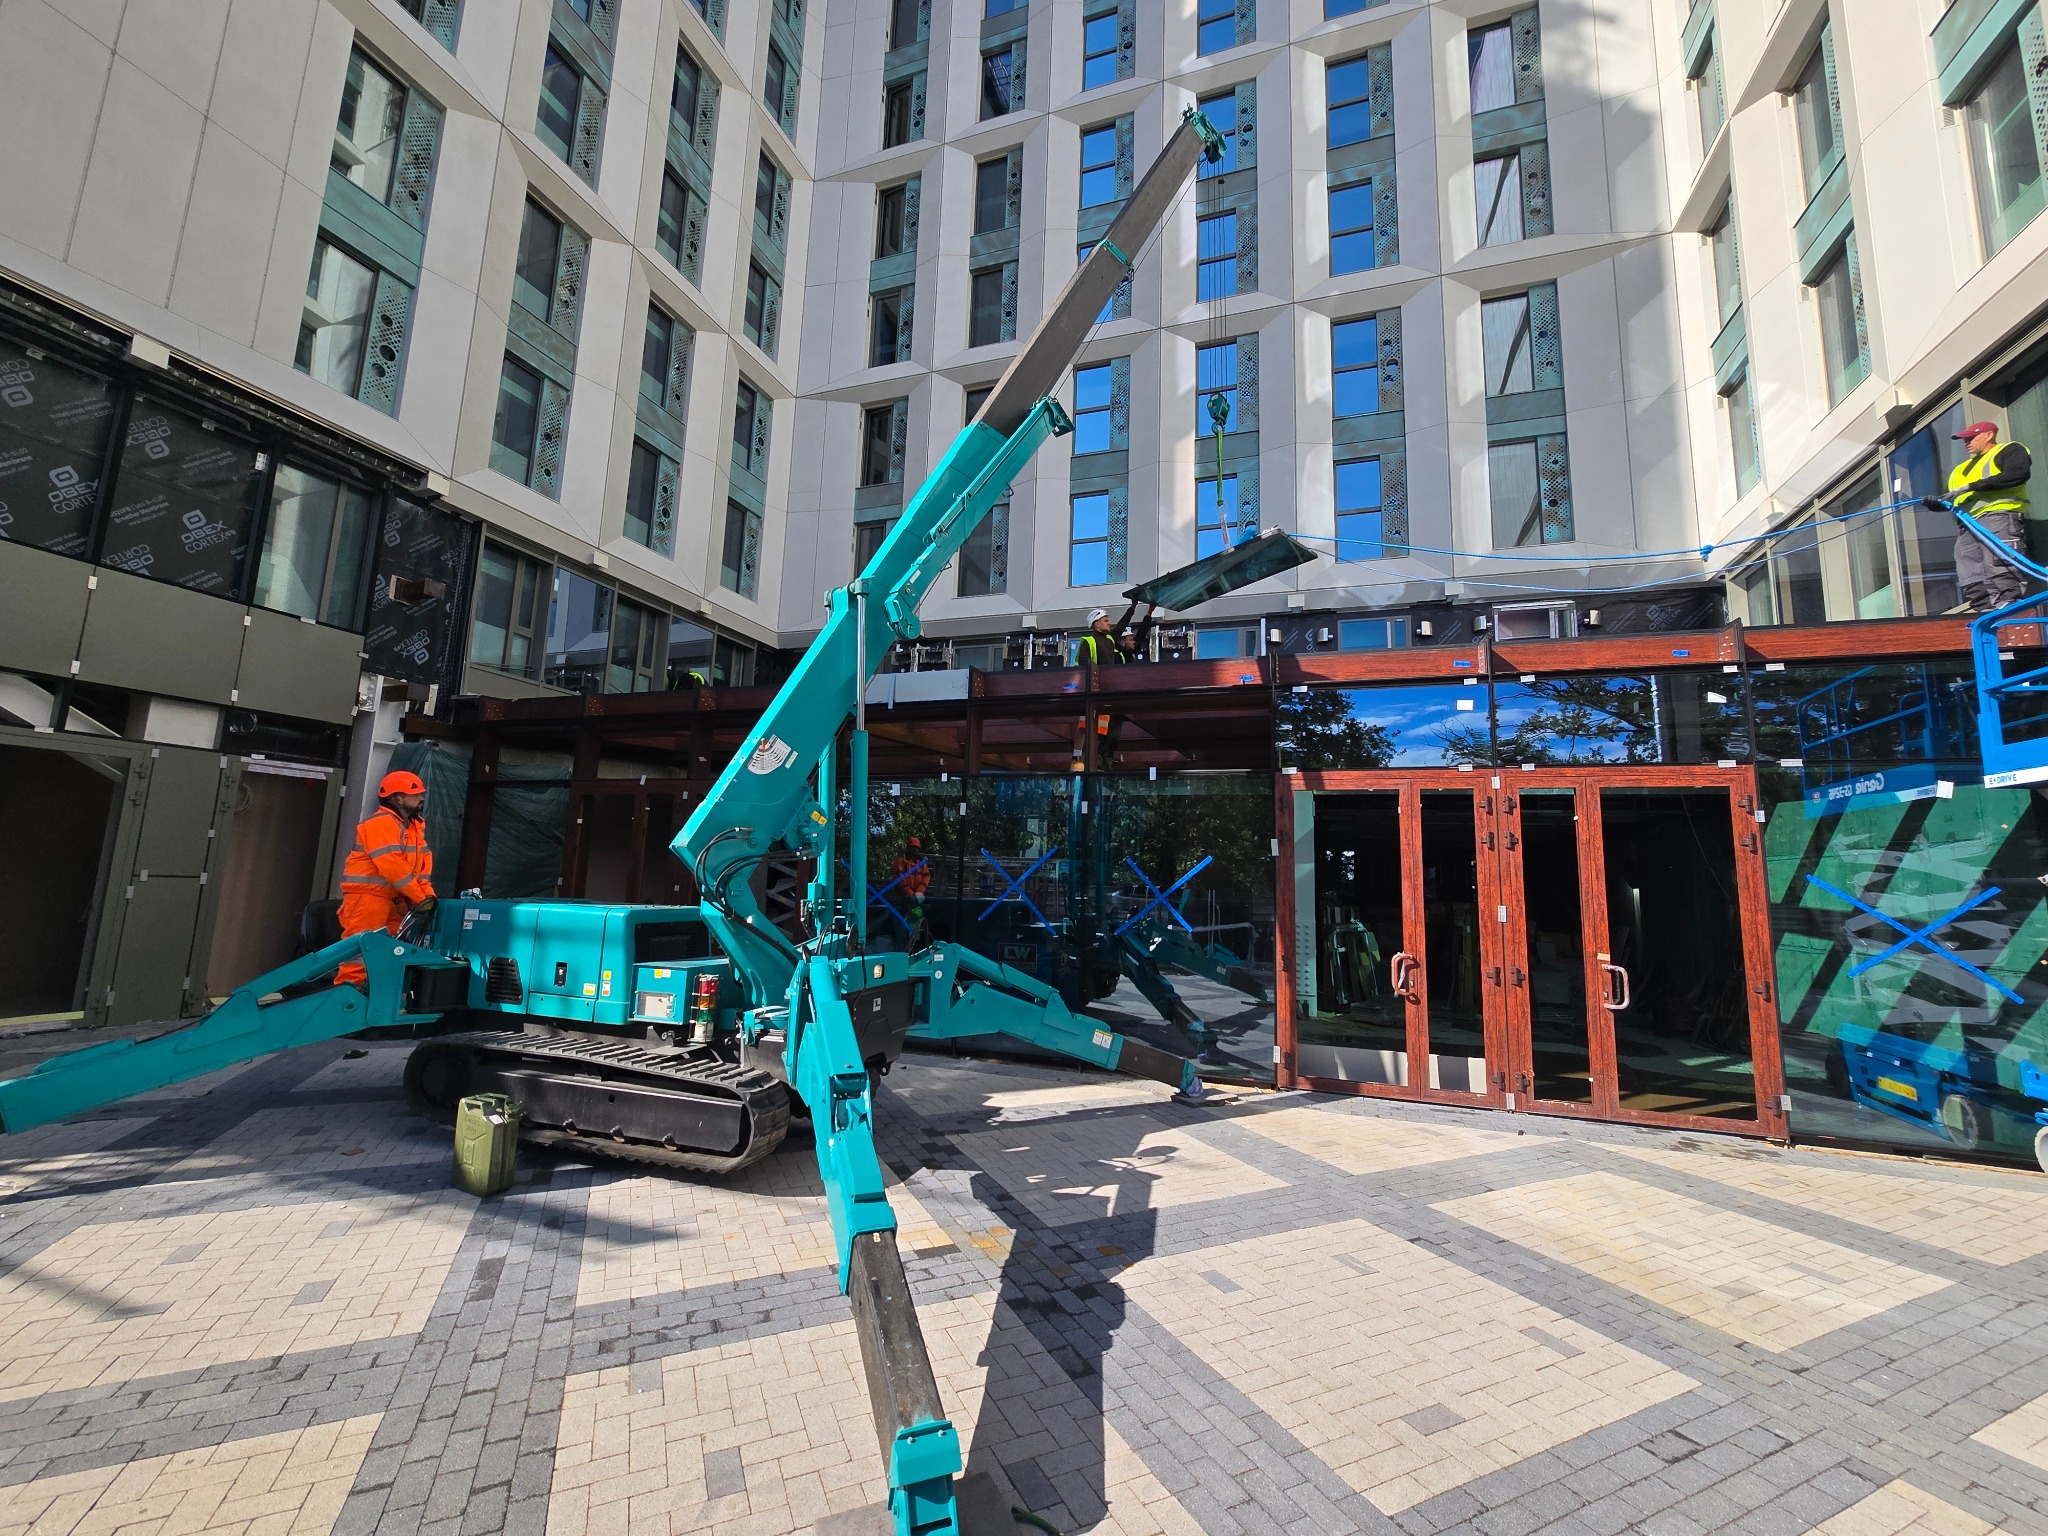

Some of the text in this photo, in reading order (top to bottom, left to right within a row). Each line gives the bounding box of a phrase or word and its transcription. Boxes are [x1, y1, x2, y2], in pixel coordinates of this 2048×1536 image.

[48, 478, 99, 503] OBEX
[53, 492, 97, 514] CORTE
[181, 520, 228, 544] OBEX
[1649, 606, 1674, 630] OBEX
[400, 636, 430, 658] OBEX
